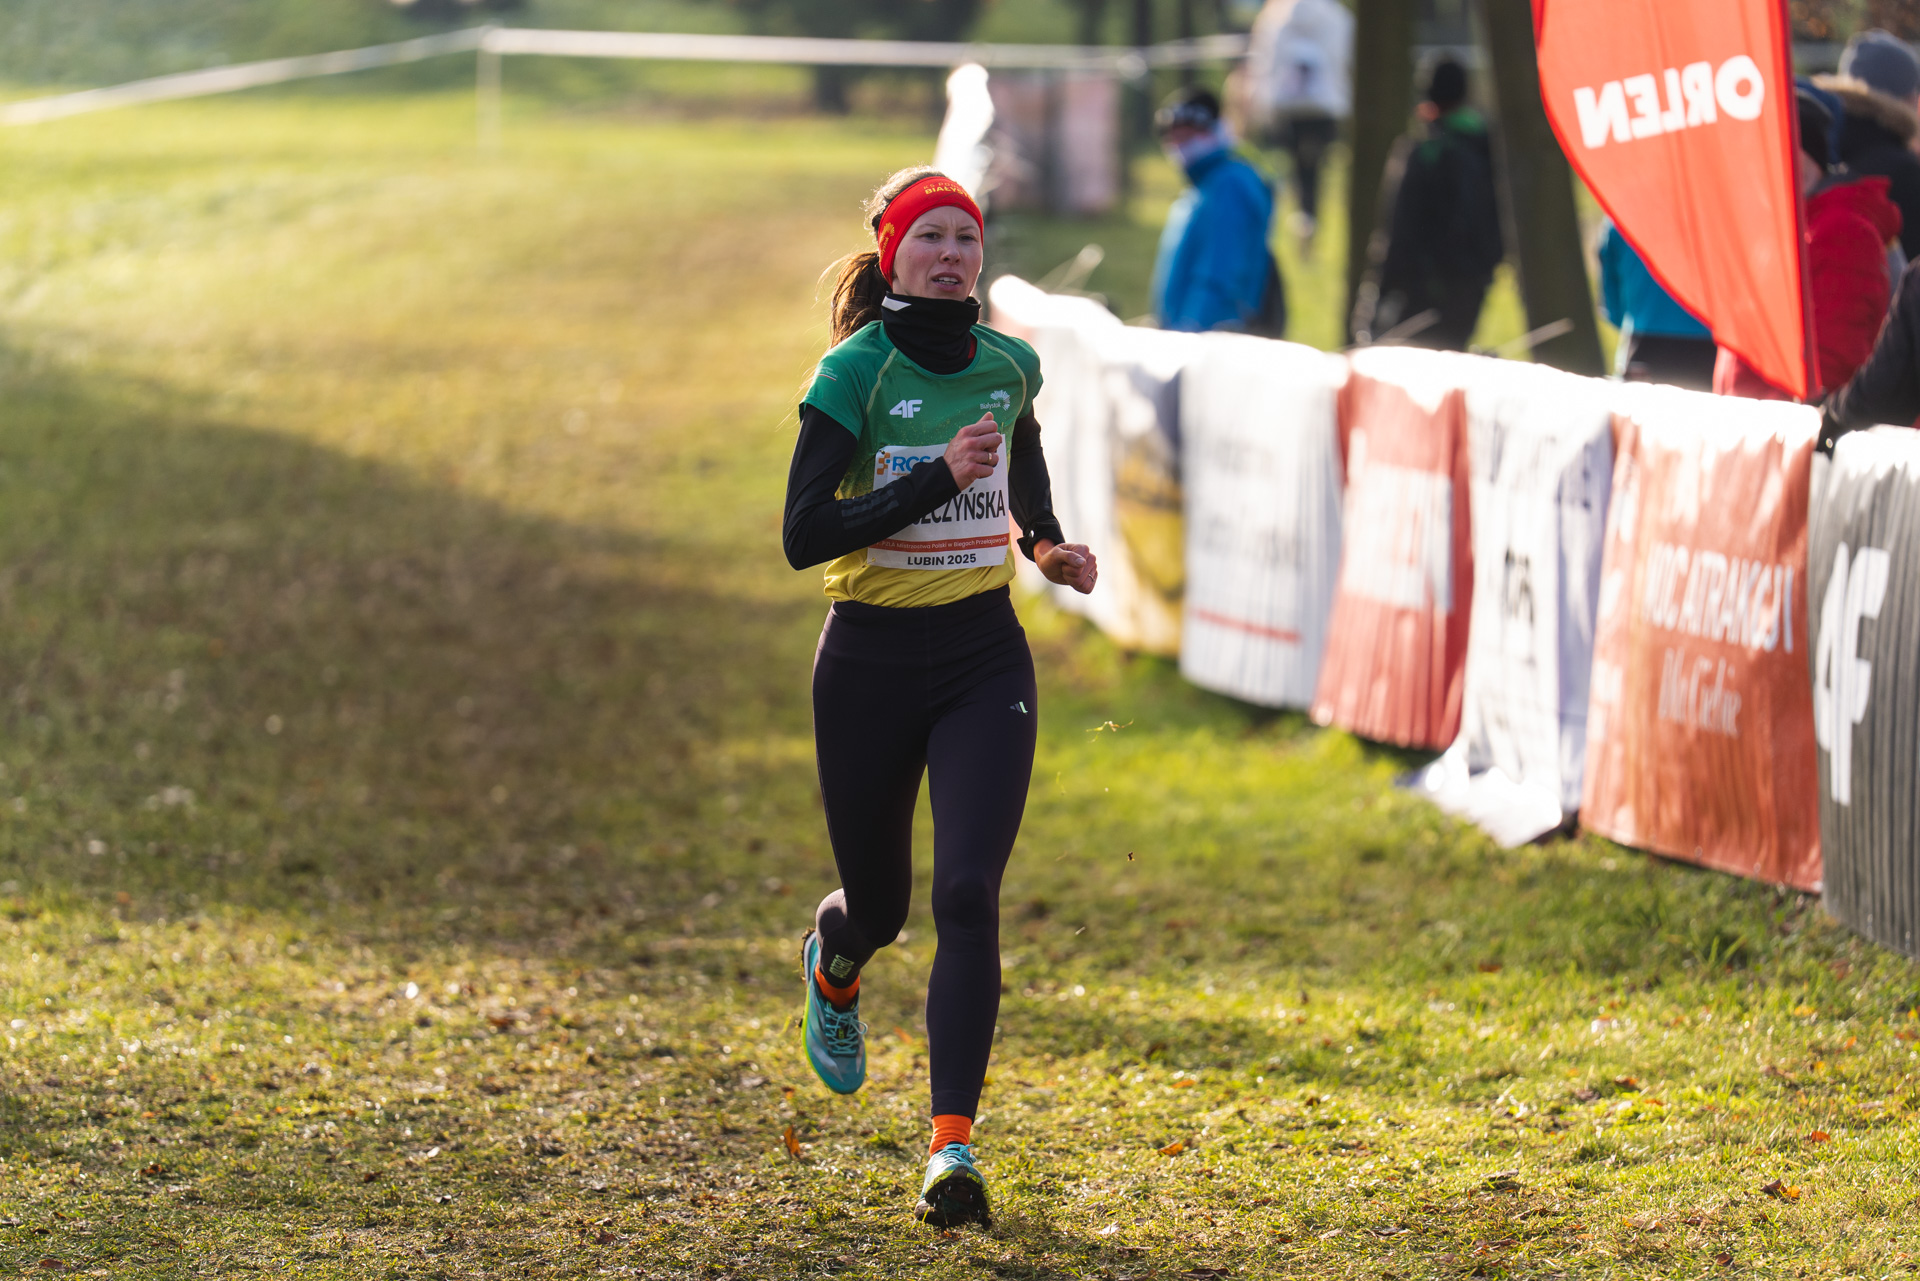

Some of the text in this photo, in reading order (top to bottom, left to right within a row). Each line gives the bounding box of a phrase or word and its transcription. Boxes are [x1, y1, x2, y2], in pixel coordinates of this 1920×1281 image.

[889, 399, 923, 419] 4F
[953, 540, 975, 548] Biegach
[907, 553, 977, 566] LUBIN 2025
[1815, 541, 1889, 807] 4F
